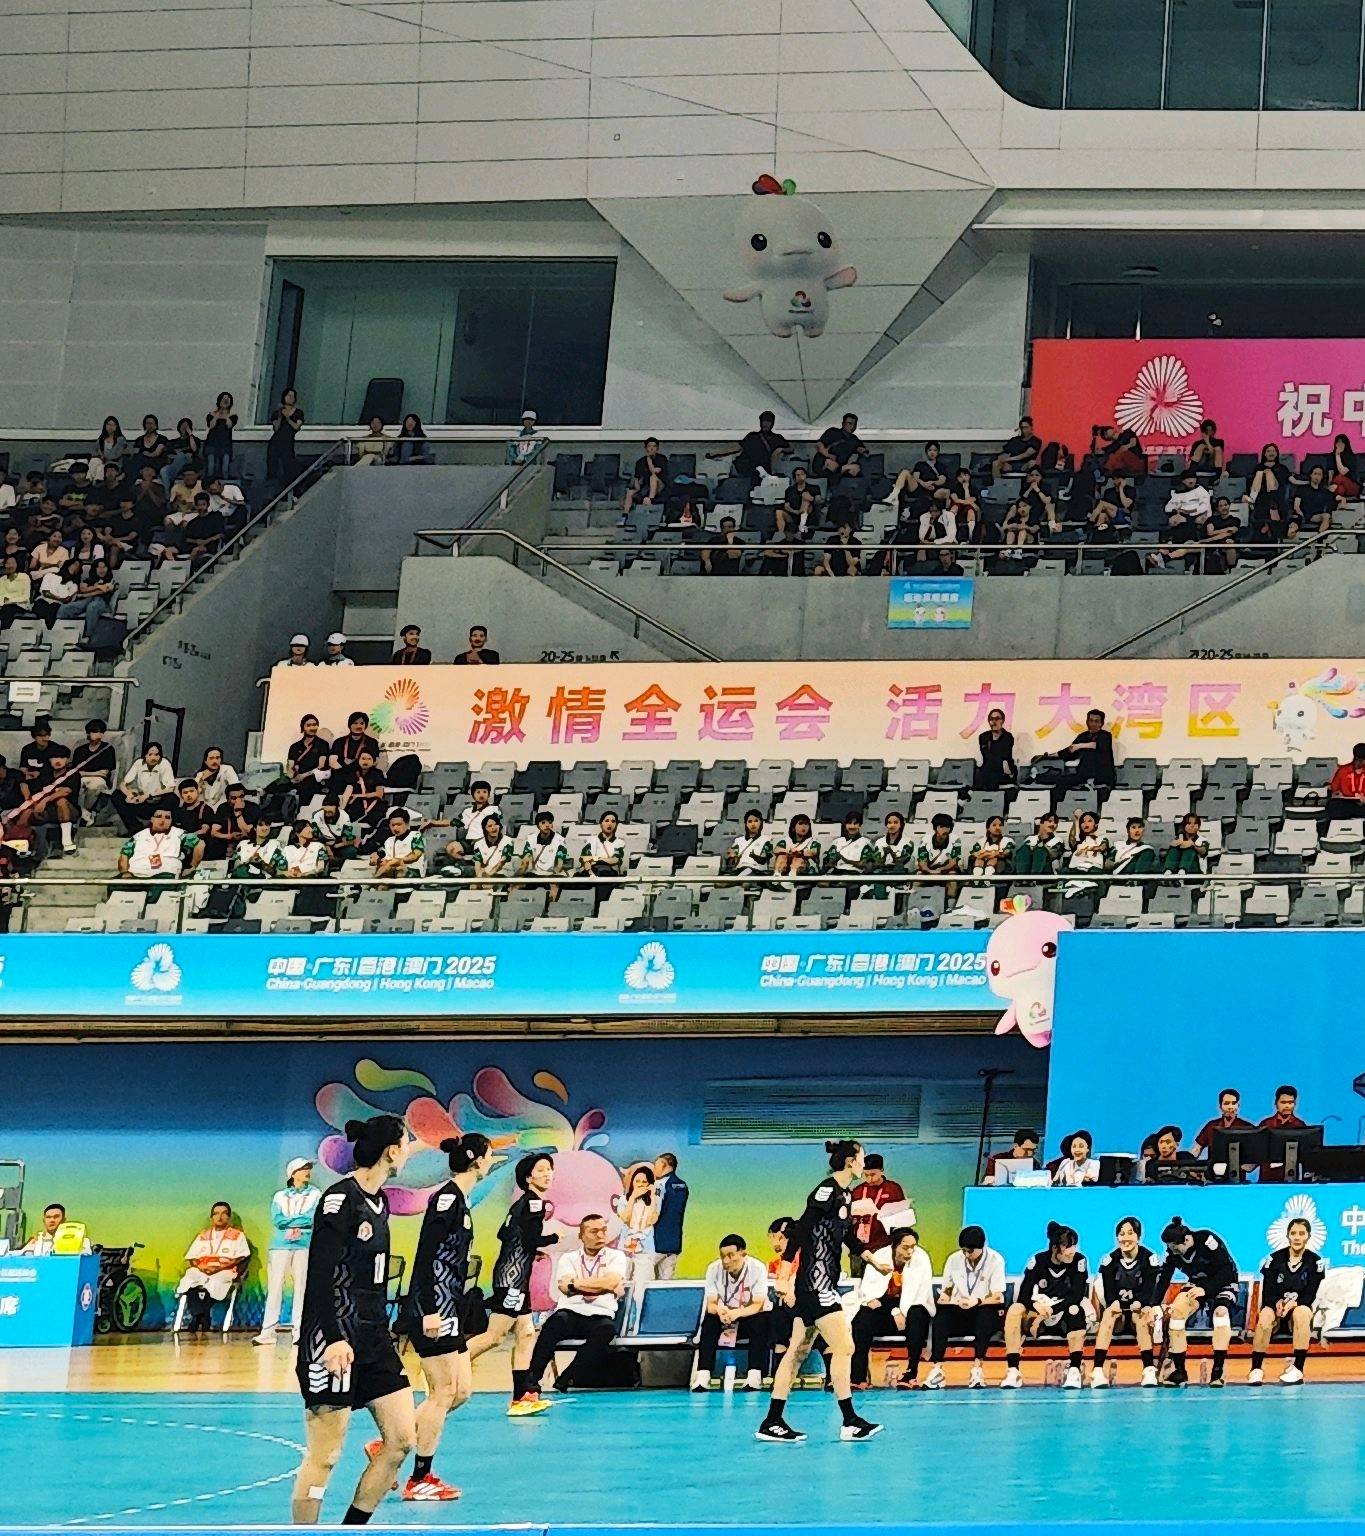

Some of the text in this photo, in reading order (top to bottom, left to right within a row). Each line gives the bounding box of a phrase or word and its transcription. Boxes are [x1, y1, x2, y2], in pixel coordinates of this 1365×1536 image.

[467, 681, 1242, 744] 激情全运会 活力大湾区
